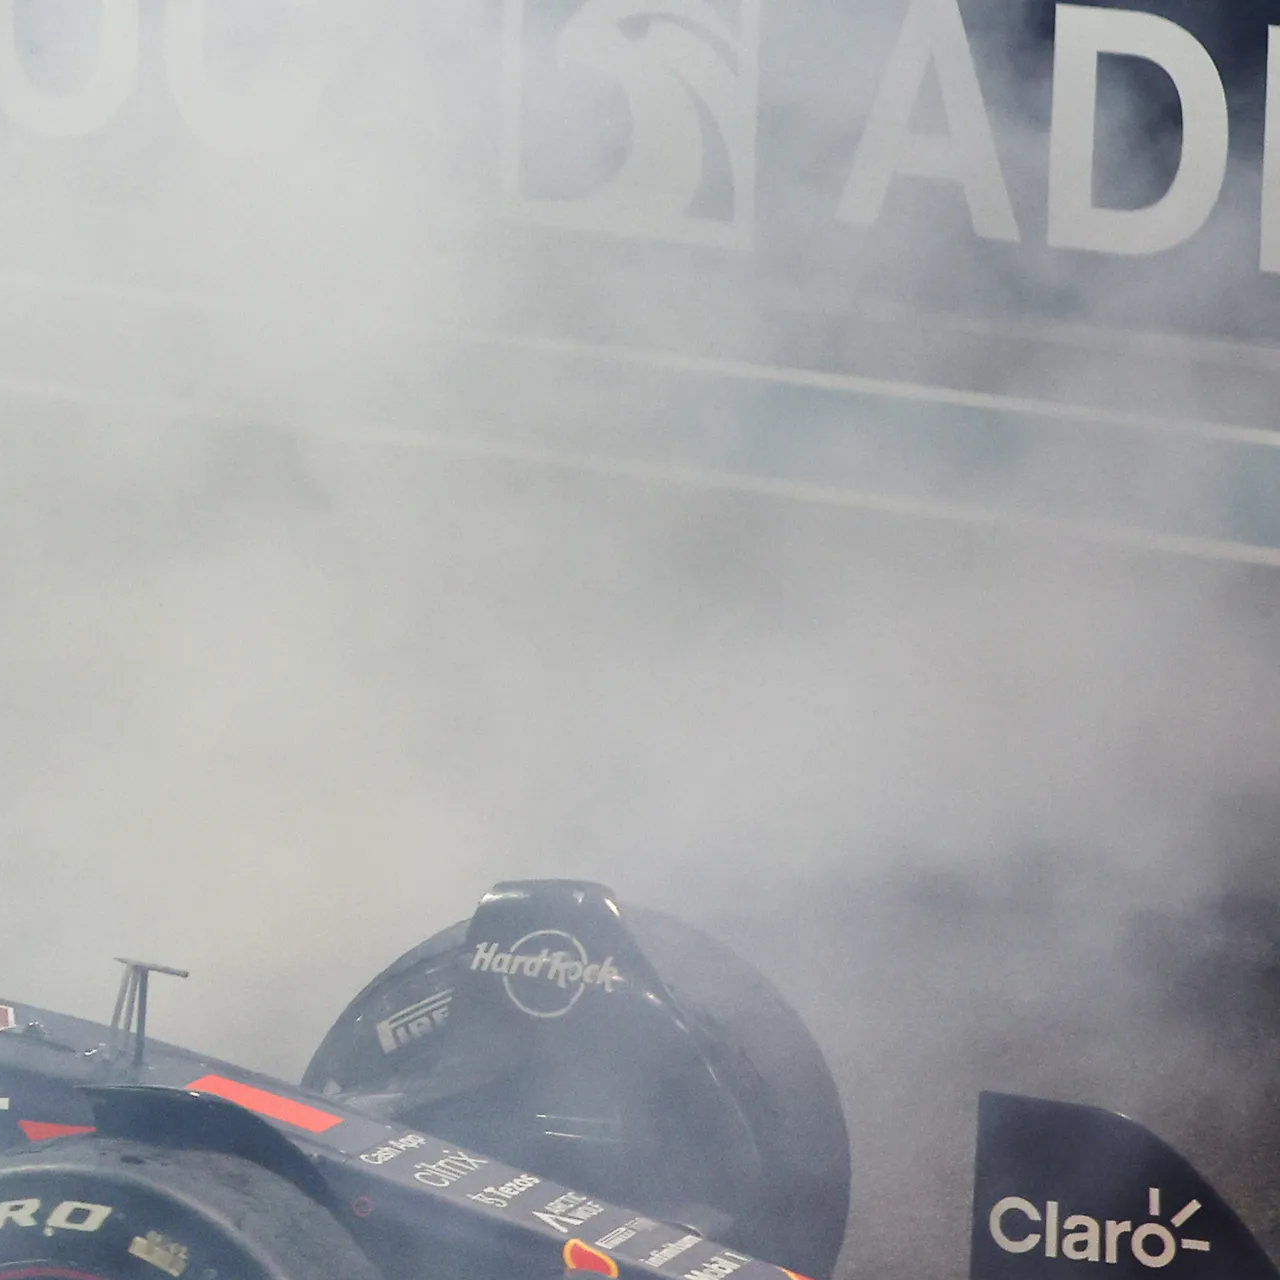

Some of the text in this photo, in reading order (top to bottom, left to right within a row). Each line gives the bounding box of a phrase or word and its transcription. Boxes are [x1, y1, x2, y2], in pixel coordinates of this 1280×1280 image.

[833, 0, 1280, 274] AD
[470, 942, 624, 993] Hard Rock
[414, 1149, 489, 1188] citrix
[989, 1195, 1177, 1268] Claro
